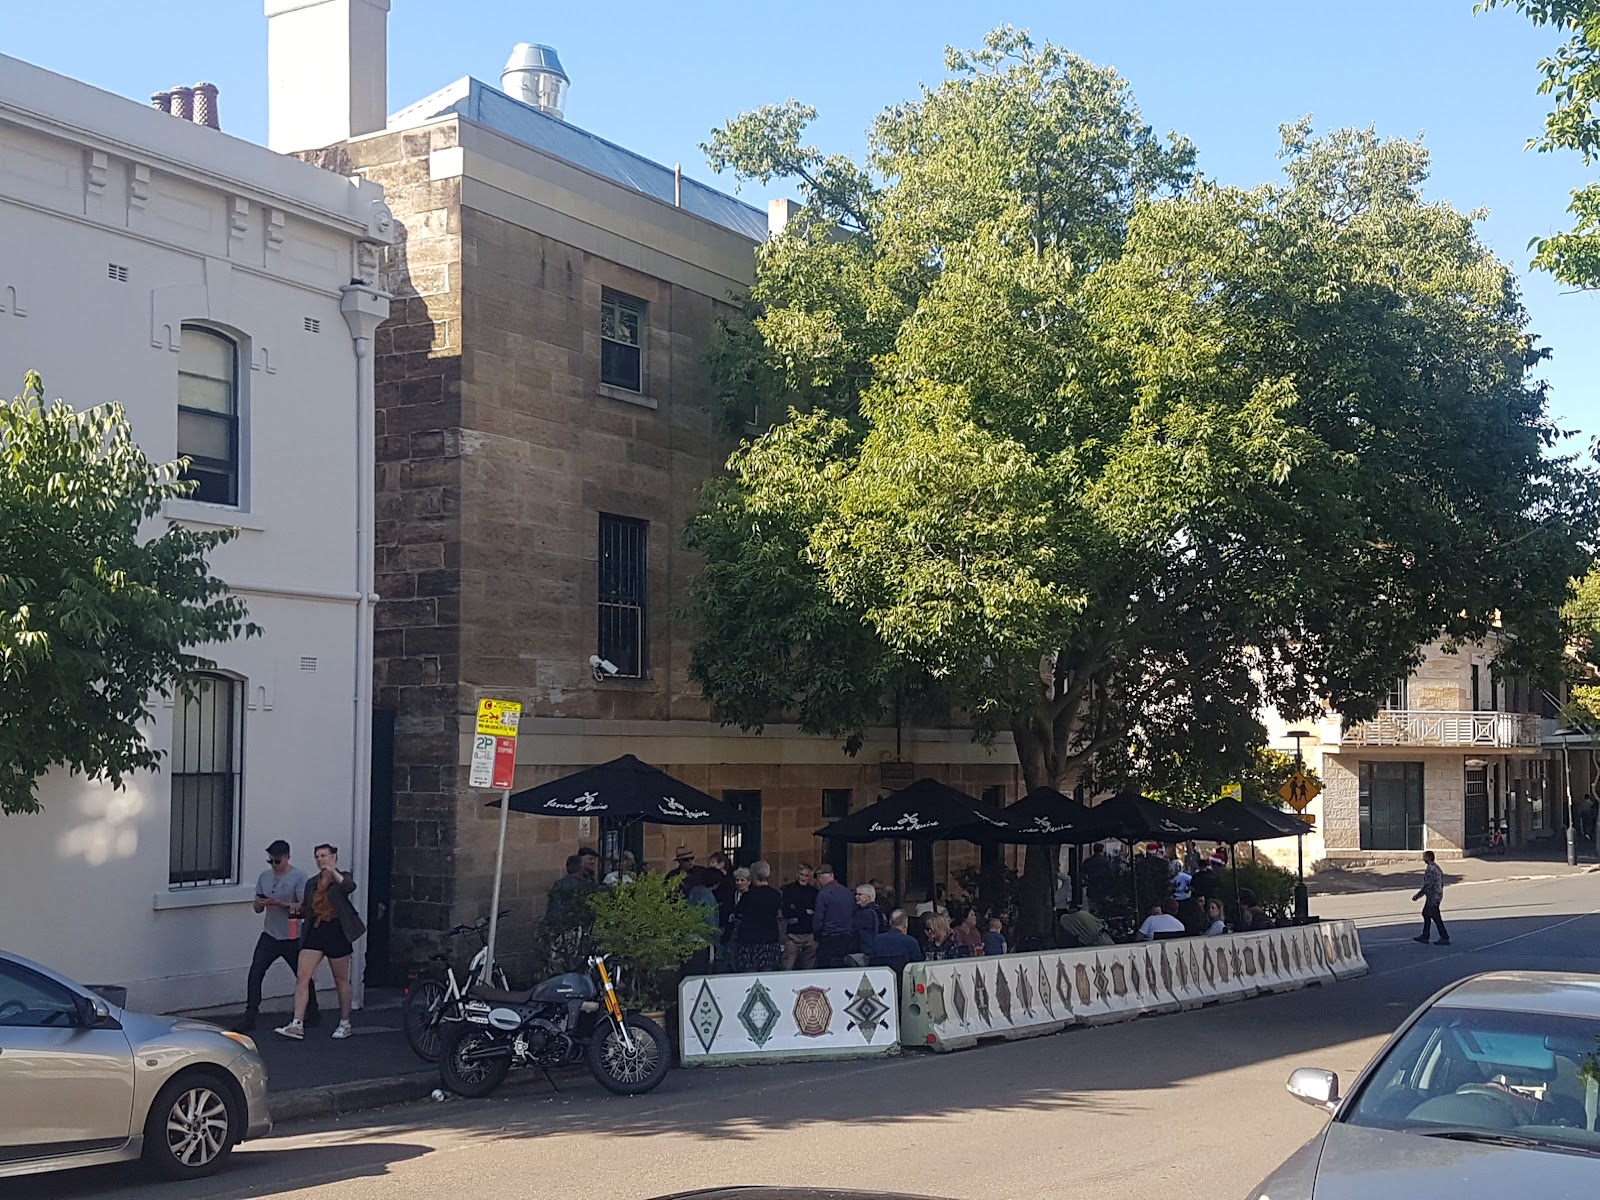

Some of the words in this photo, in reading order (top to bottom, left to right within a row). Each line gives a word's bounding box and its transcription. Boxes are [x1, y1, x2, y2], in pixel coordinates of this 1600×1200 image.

[476, 737, 493, 749] 2P
[543, 798, 577, 809] James
[577, 802, 609, 812] Squire
[869, 821, 905, 832] James
[906, 820, 940, 832] Squire
[1042, 823, 1074, 834] Squire
